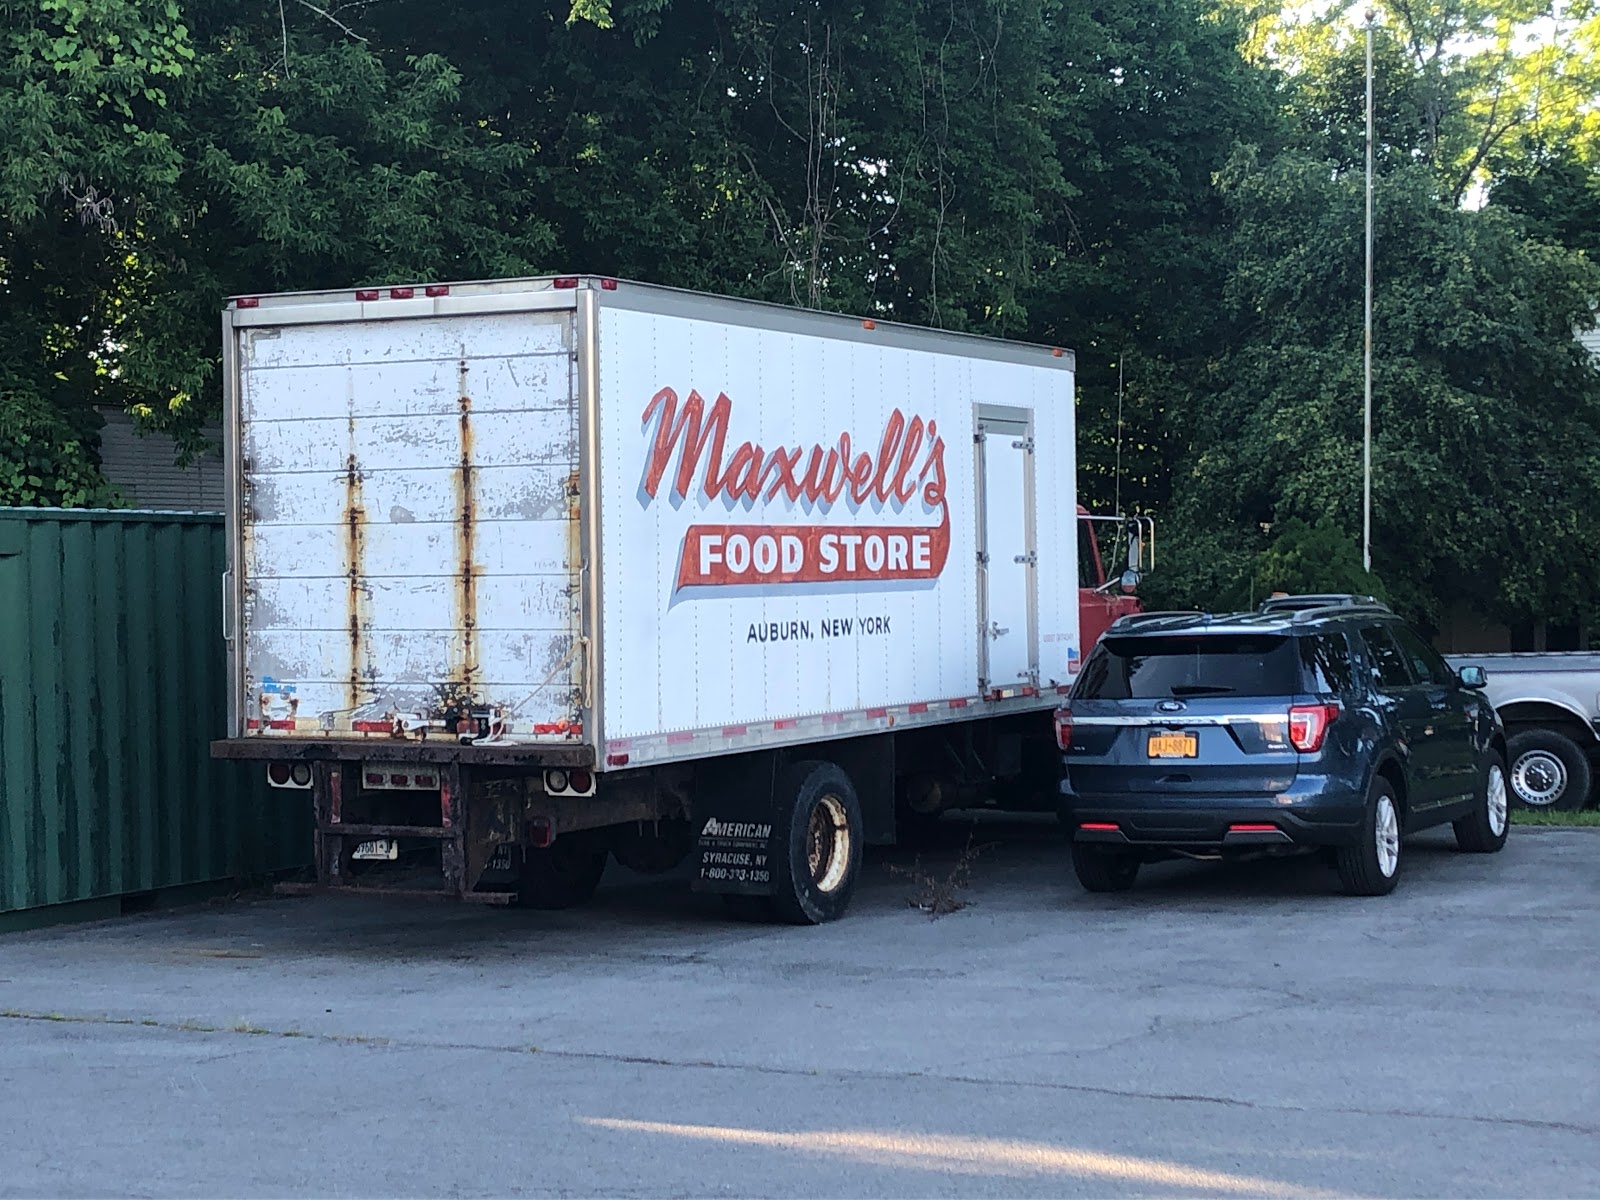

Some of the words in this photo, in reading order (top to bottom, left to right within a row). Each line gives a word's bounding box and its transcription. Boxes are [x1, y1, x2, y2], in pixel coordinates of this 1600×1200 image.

[636, 386, 947, 514] Maxwell's
[699, 534, 803, 576] FOOD
[818, 534, 932, 573] STORE
[746, 619, 815, 644] AUBURN,
[820, 617, 854, 638] NEW
[859, 615, 892, 635] YORK
[701, 817, 772, 838] AMERICAN
[702, 851, 753, 867] SYRACUSE,
[755, 854, 768, 867] NY
